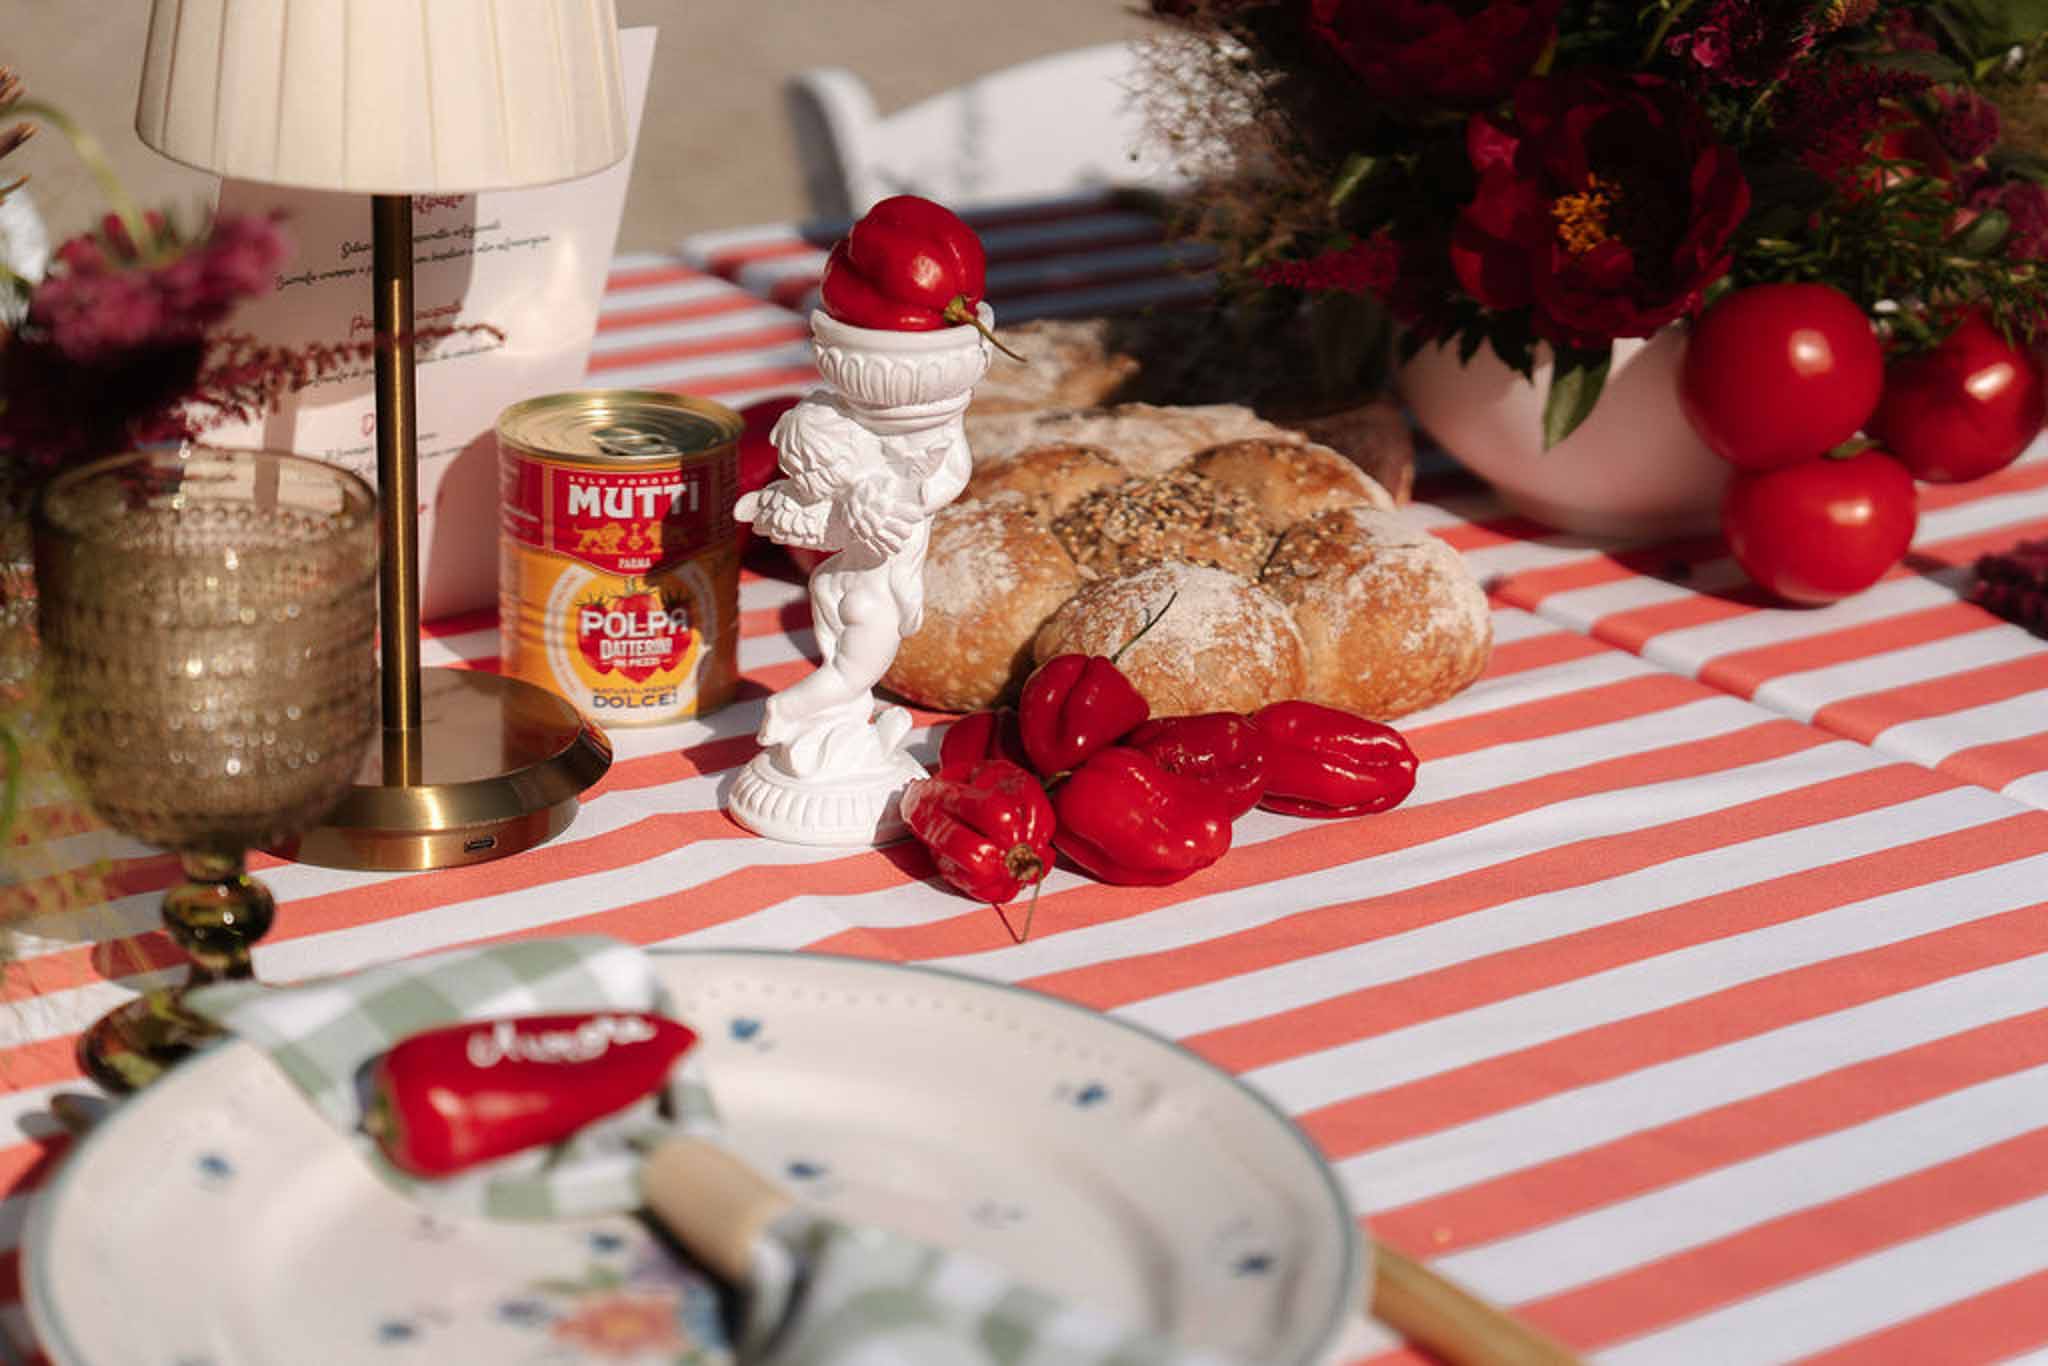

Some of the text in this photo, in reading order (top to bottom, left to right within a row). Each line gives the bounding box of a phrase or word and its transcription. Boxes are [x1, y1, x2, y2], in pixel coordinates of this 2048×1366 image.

[568, 480, 700, 519] MUTTI
[618, 557, 652, 569] PARMA
[580, 608, 689, 638] POLPA
